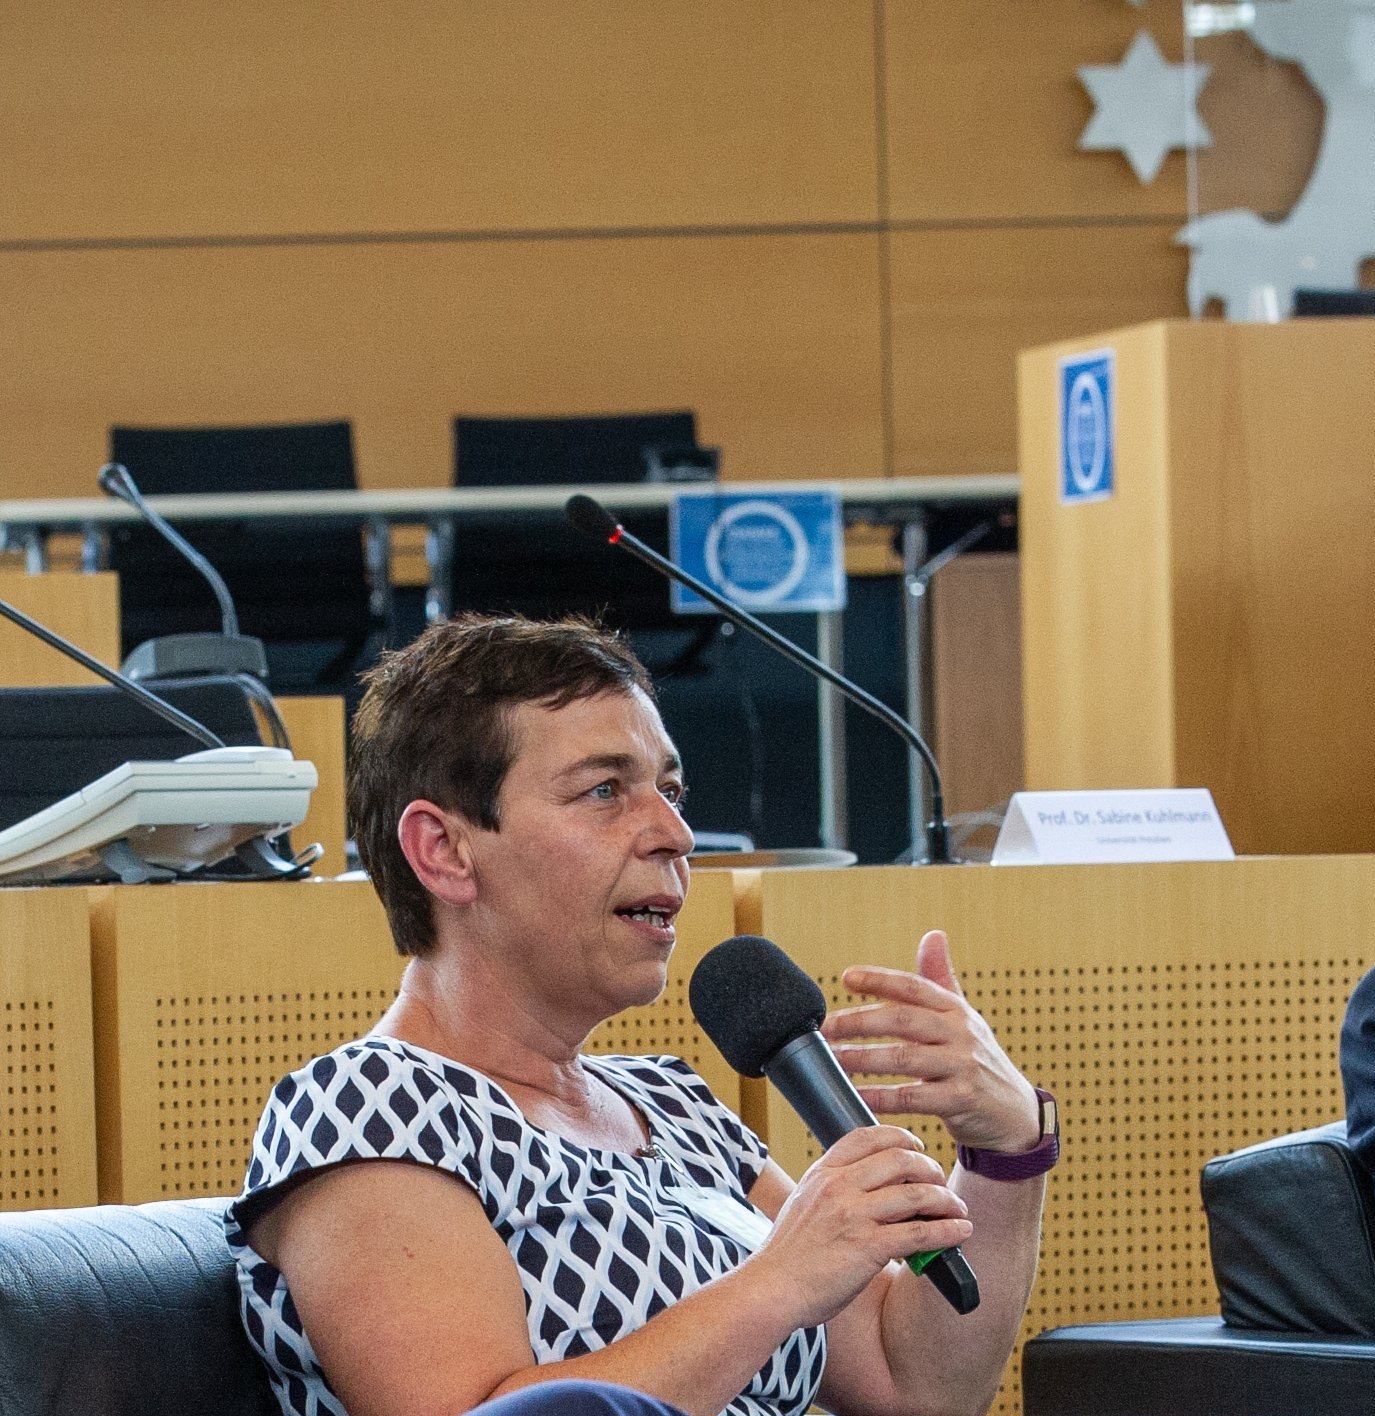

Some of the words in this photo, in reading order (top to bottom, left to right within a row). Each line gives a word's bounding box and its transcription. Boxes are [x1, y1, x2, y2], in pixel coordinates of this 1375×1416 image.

[1038, 810, 1073, 825] Prof.
[1074, 811, 1096, 825] Dr.
[1097, 810, 1142, 824] Sabine
[1144, 809, 1213, 823] Kuhlmann
